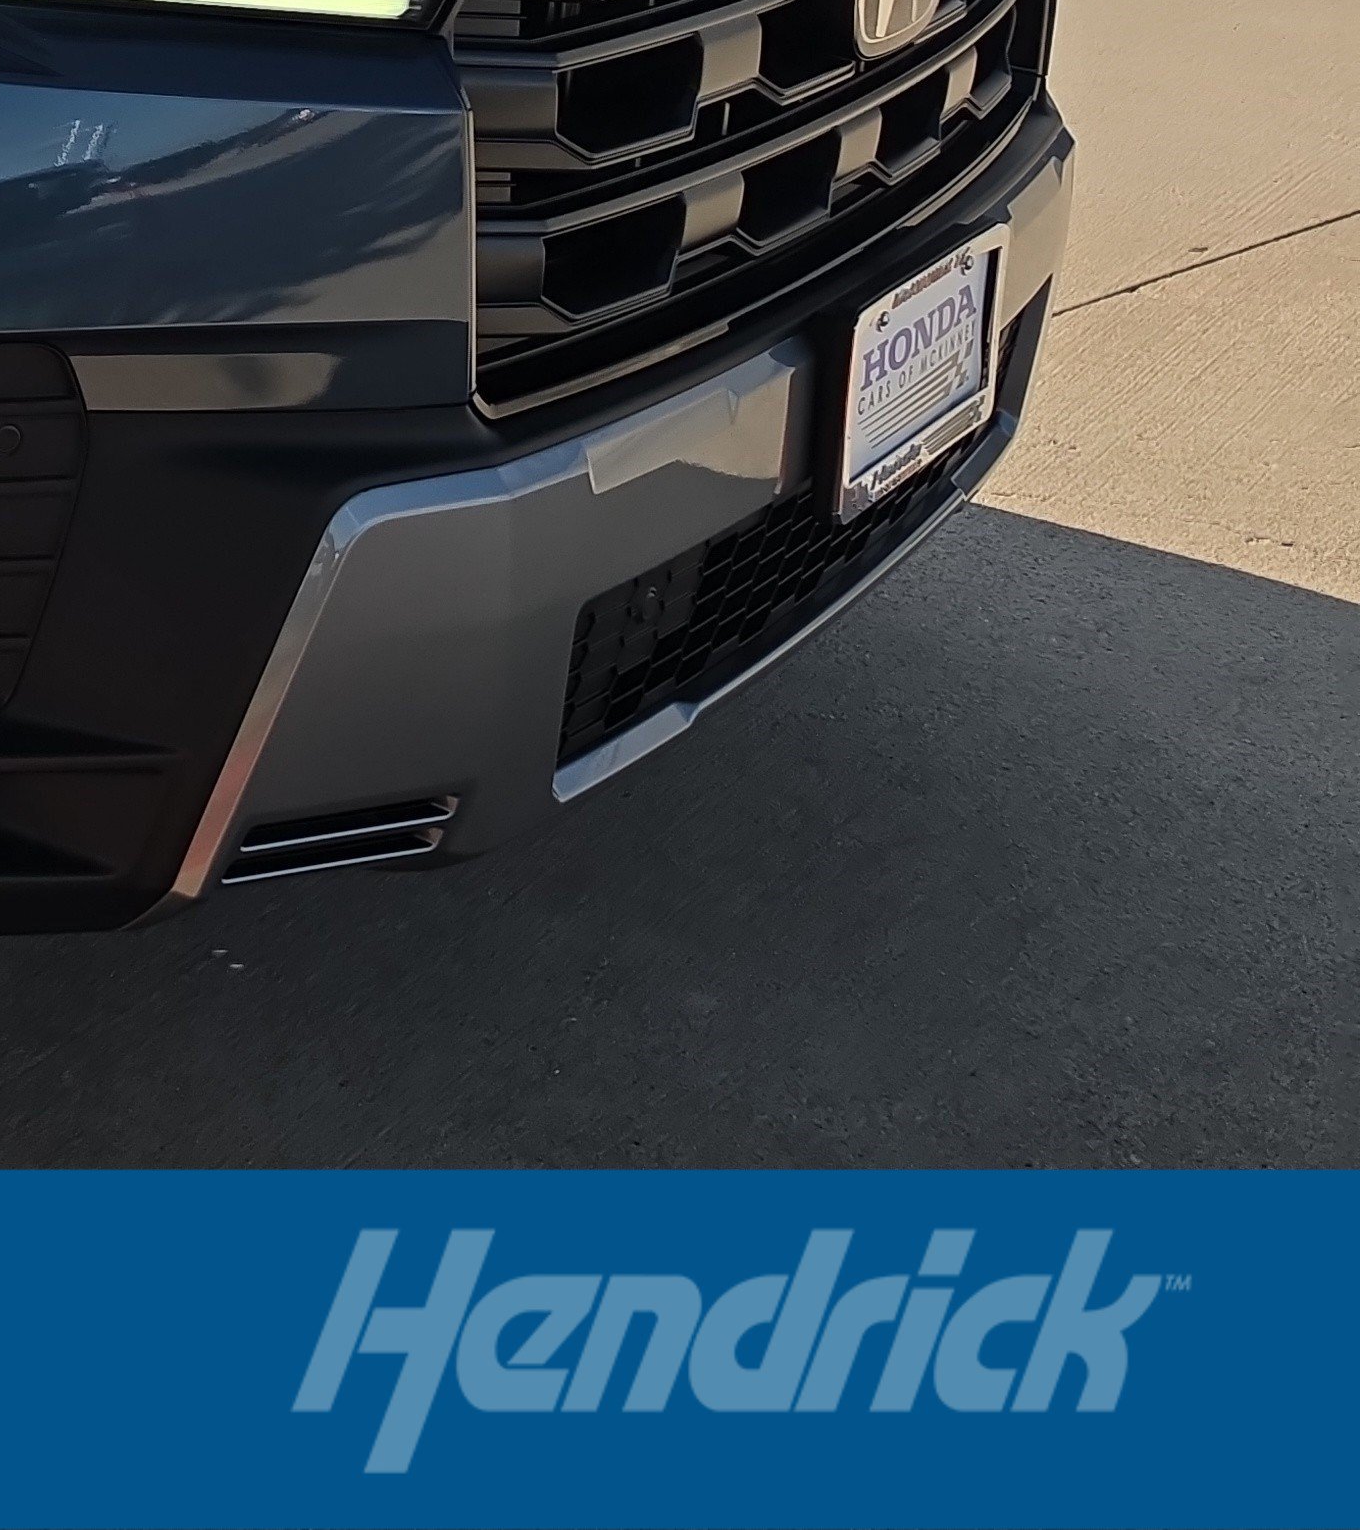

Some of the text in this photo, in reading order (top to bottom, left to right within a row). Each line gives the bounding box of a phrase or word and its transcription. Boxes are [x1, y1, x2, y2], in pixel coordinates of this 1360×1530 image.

[860, 284, 977, 392] HONDA
[857, 379, 891, 416] CARS
[898, 367, 915, 390] OF
